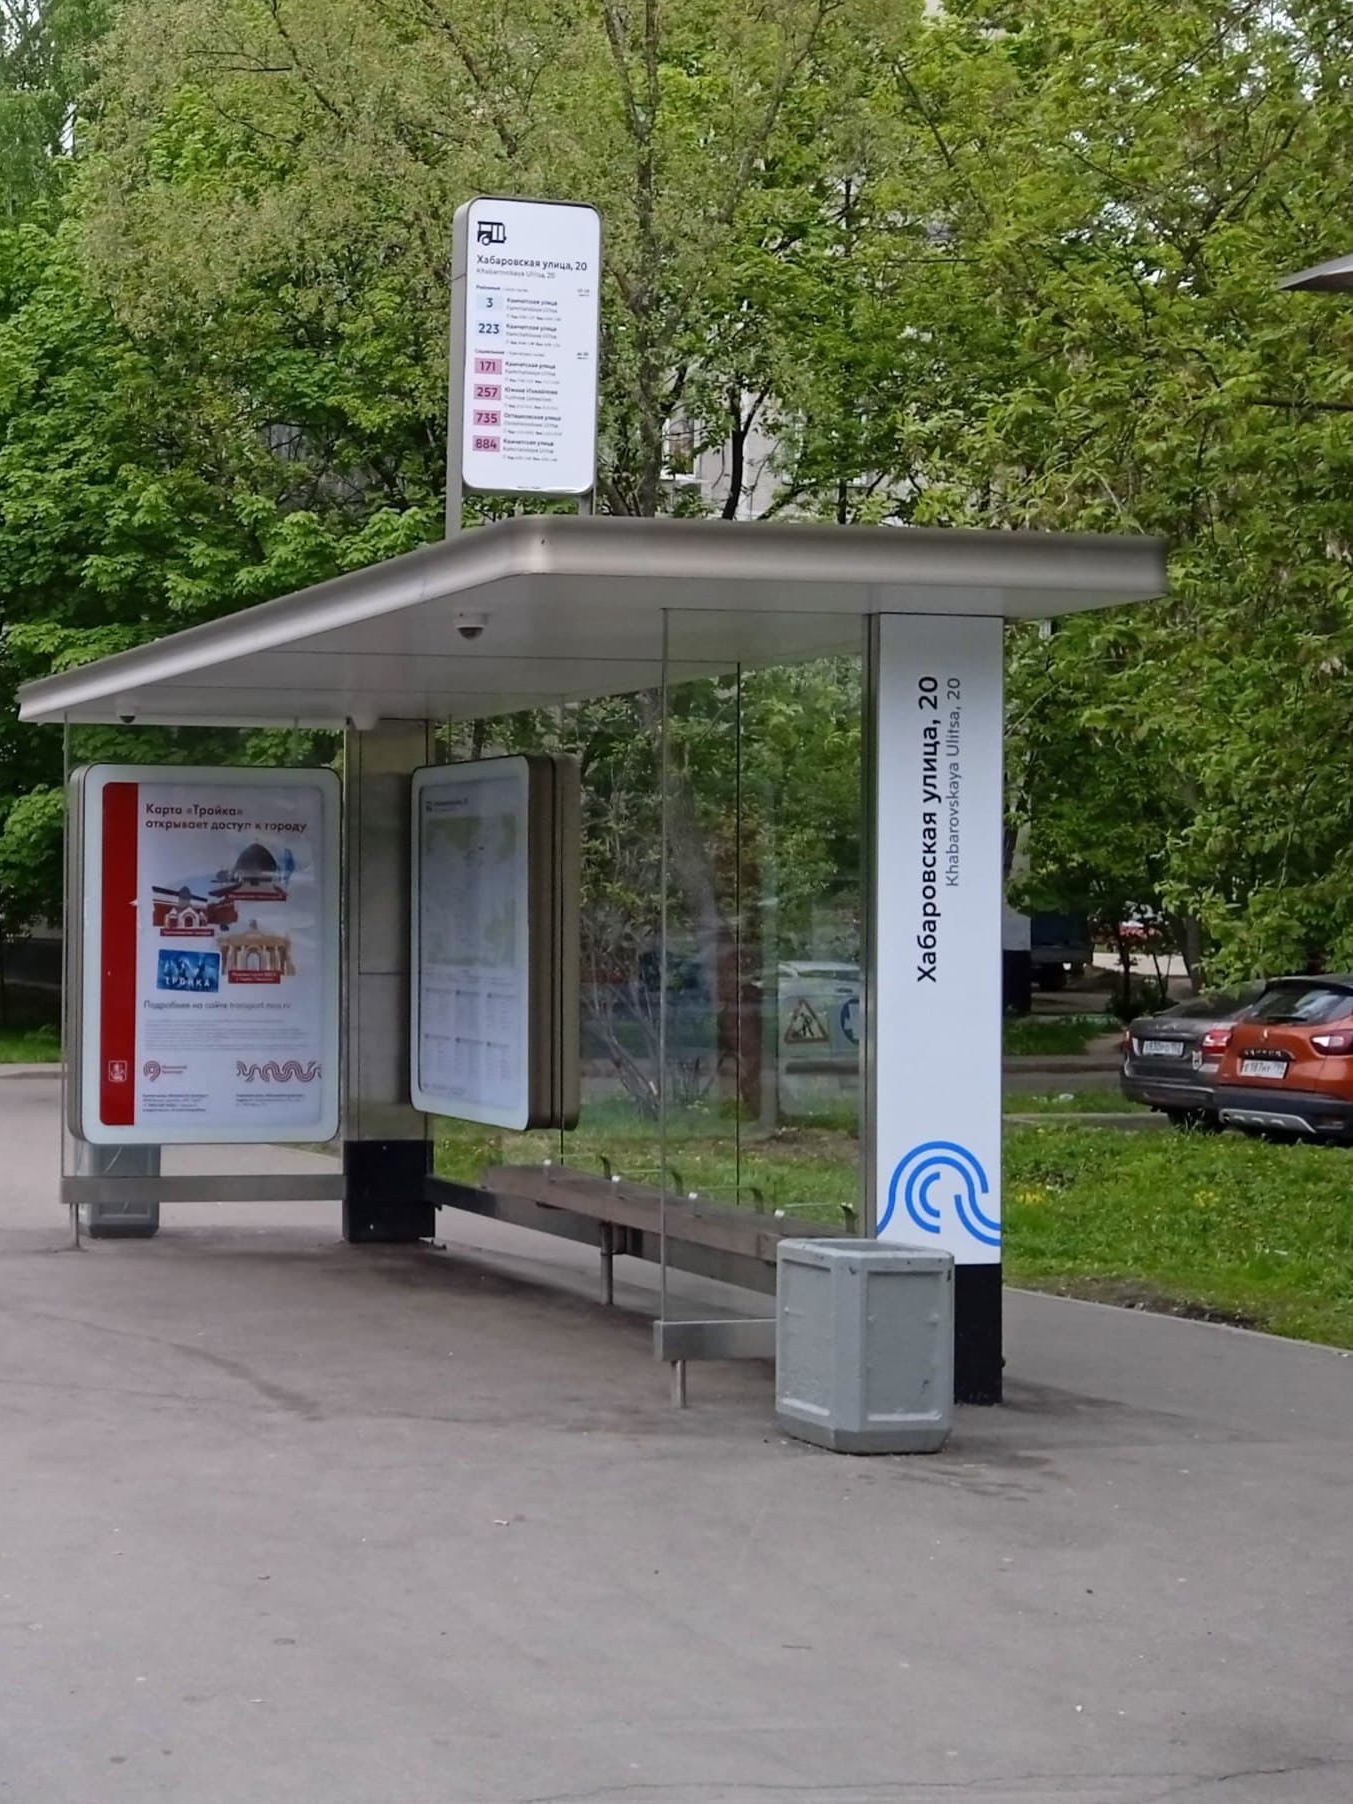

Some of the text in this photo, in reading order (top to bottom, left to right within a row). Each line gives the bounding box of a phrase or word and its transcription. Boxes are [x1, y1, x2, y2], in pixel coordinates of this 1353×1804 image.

[476, 254, 588, 272] Хабаровская улица, 20
[486, 297, 494, 308] 3
[478, 322, 500, 335] 223
[480, 360, 496, 372] 171
[477, 386, 498, 398] 257
[477, 412, 498, 424] 735
[475, 438, 497, 450] 884
[946, 677, 962, 886] Khabarovskaya Ulitsa, 20
[146, 803, 243, 817] Карта «Тройка»
[146, 819, 208, 831] открывает
[211, 822, 249, 832] доступ
[265, 822, 307, 833] городу
[917, 675, 941, 982] Хабаровская улица, 20
